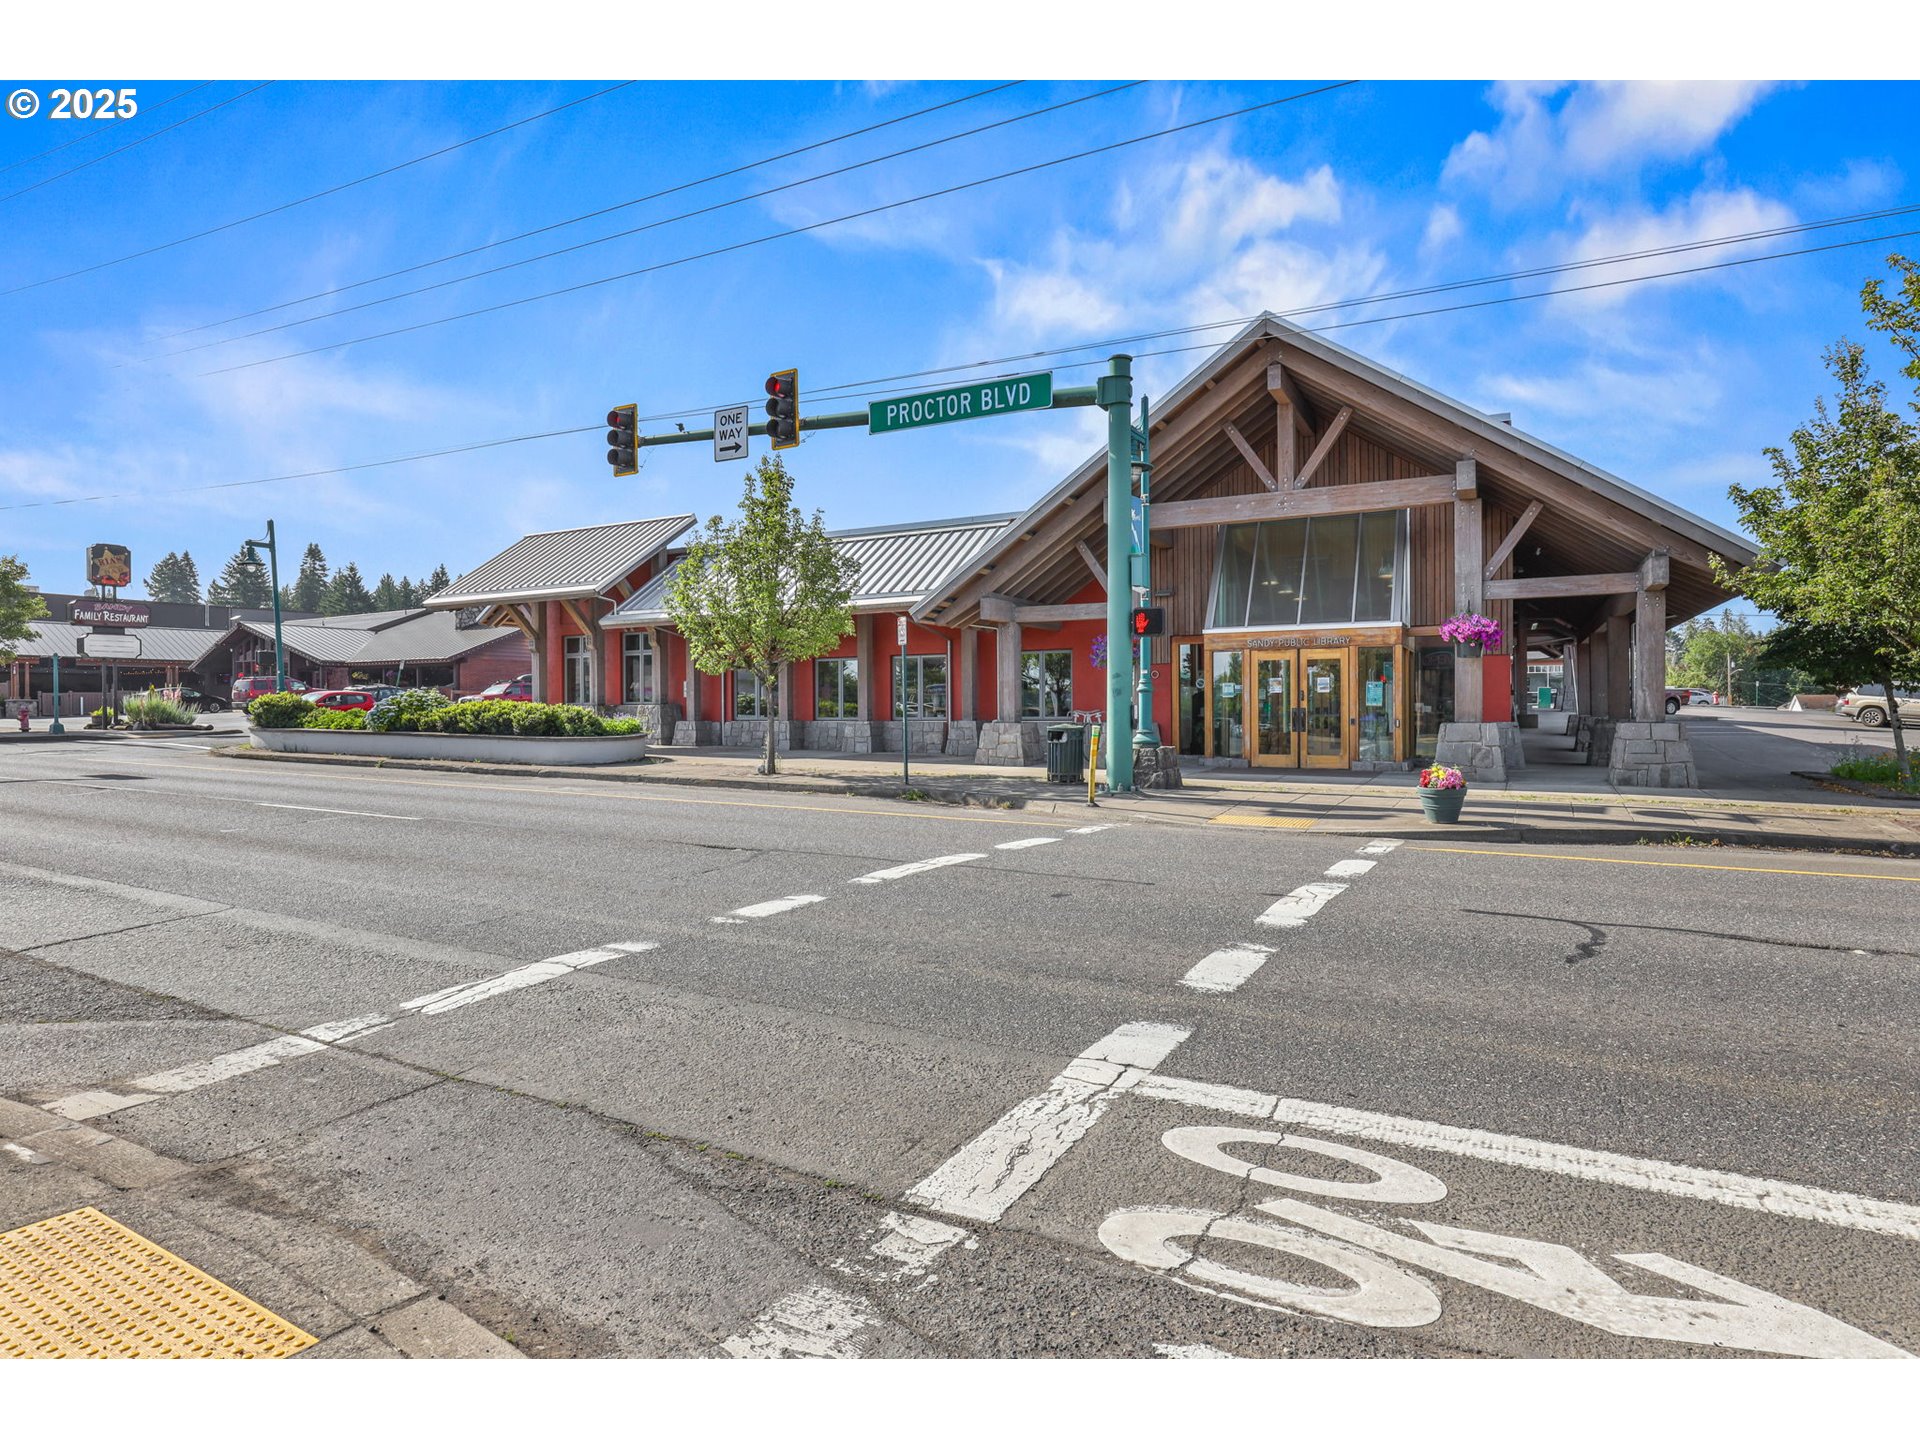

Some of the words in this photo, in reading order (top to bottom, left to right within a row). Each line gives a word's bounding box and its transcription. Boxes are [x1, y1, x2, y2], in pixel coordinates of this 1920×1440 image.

[886, 392, 972, 426] PROCTOR
[981, 382, 1031, 411] BLVD
[720, 412, 743, 426] ONE
[719, 426, 743, 441] WAY
[74, 609, 102, 621] FAMILY
[103, 611, 149, 623] RESTAURANT
[1247, 639, 1275, 648] SANDY
[1278, 638, 1310, 647] PUBLIC
[1313, 636, 1351, 646] LIBRARY
